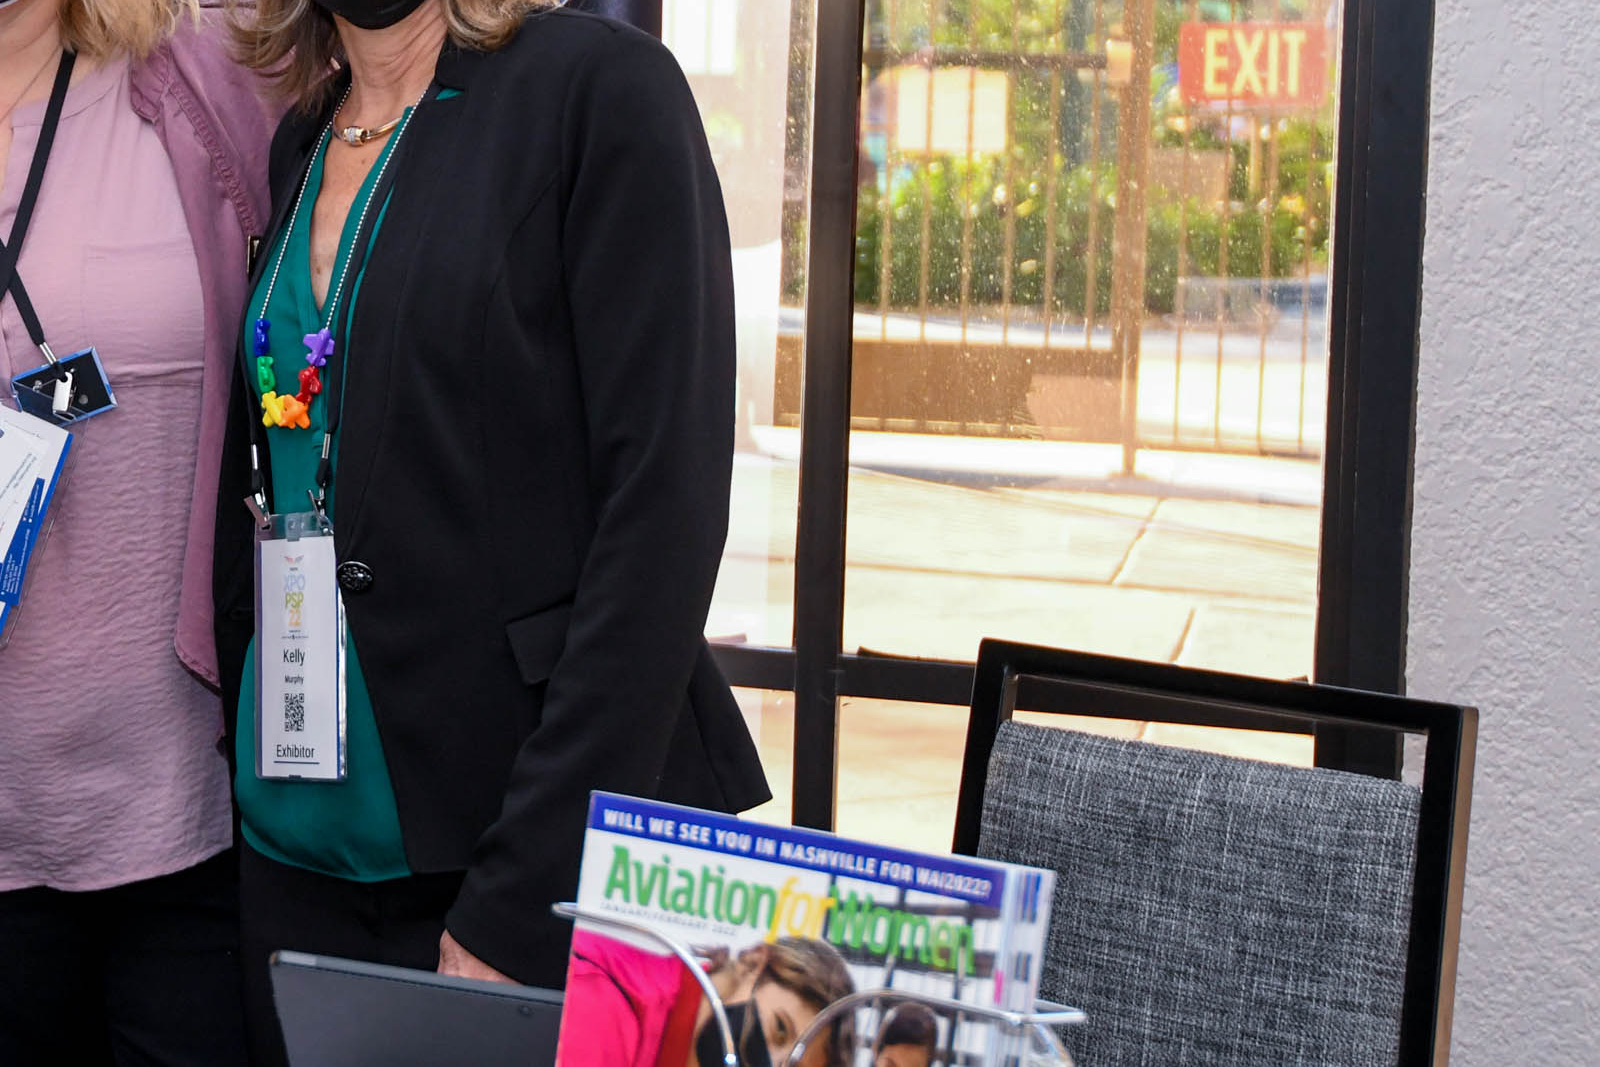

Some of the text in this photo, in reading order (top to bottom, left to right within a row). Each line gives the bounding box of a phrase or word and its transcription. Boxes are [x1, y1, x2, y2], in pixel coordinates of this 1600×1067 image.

[1203, 29, 1306, 96] EXIT
[283, 649, 305, 666] Kelly
[284, 675, 304, 685] Murphy
[276, 744, 315, 758] Exhibitor
[604, 809, 644, 831] WILL
[649, 817, 675, 837] WE
[679, 822, 711, 844] SEE
[715, 829, 752, 852] YOU
[755, 837, 776, 856] IN
[779, 841, 877, 874] NASHVILLE
[880, 860, 914, 883] FOR
[604, 845, 976, 975] Aviation for Women
